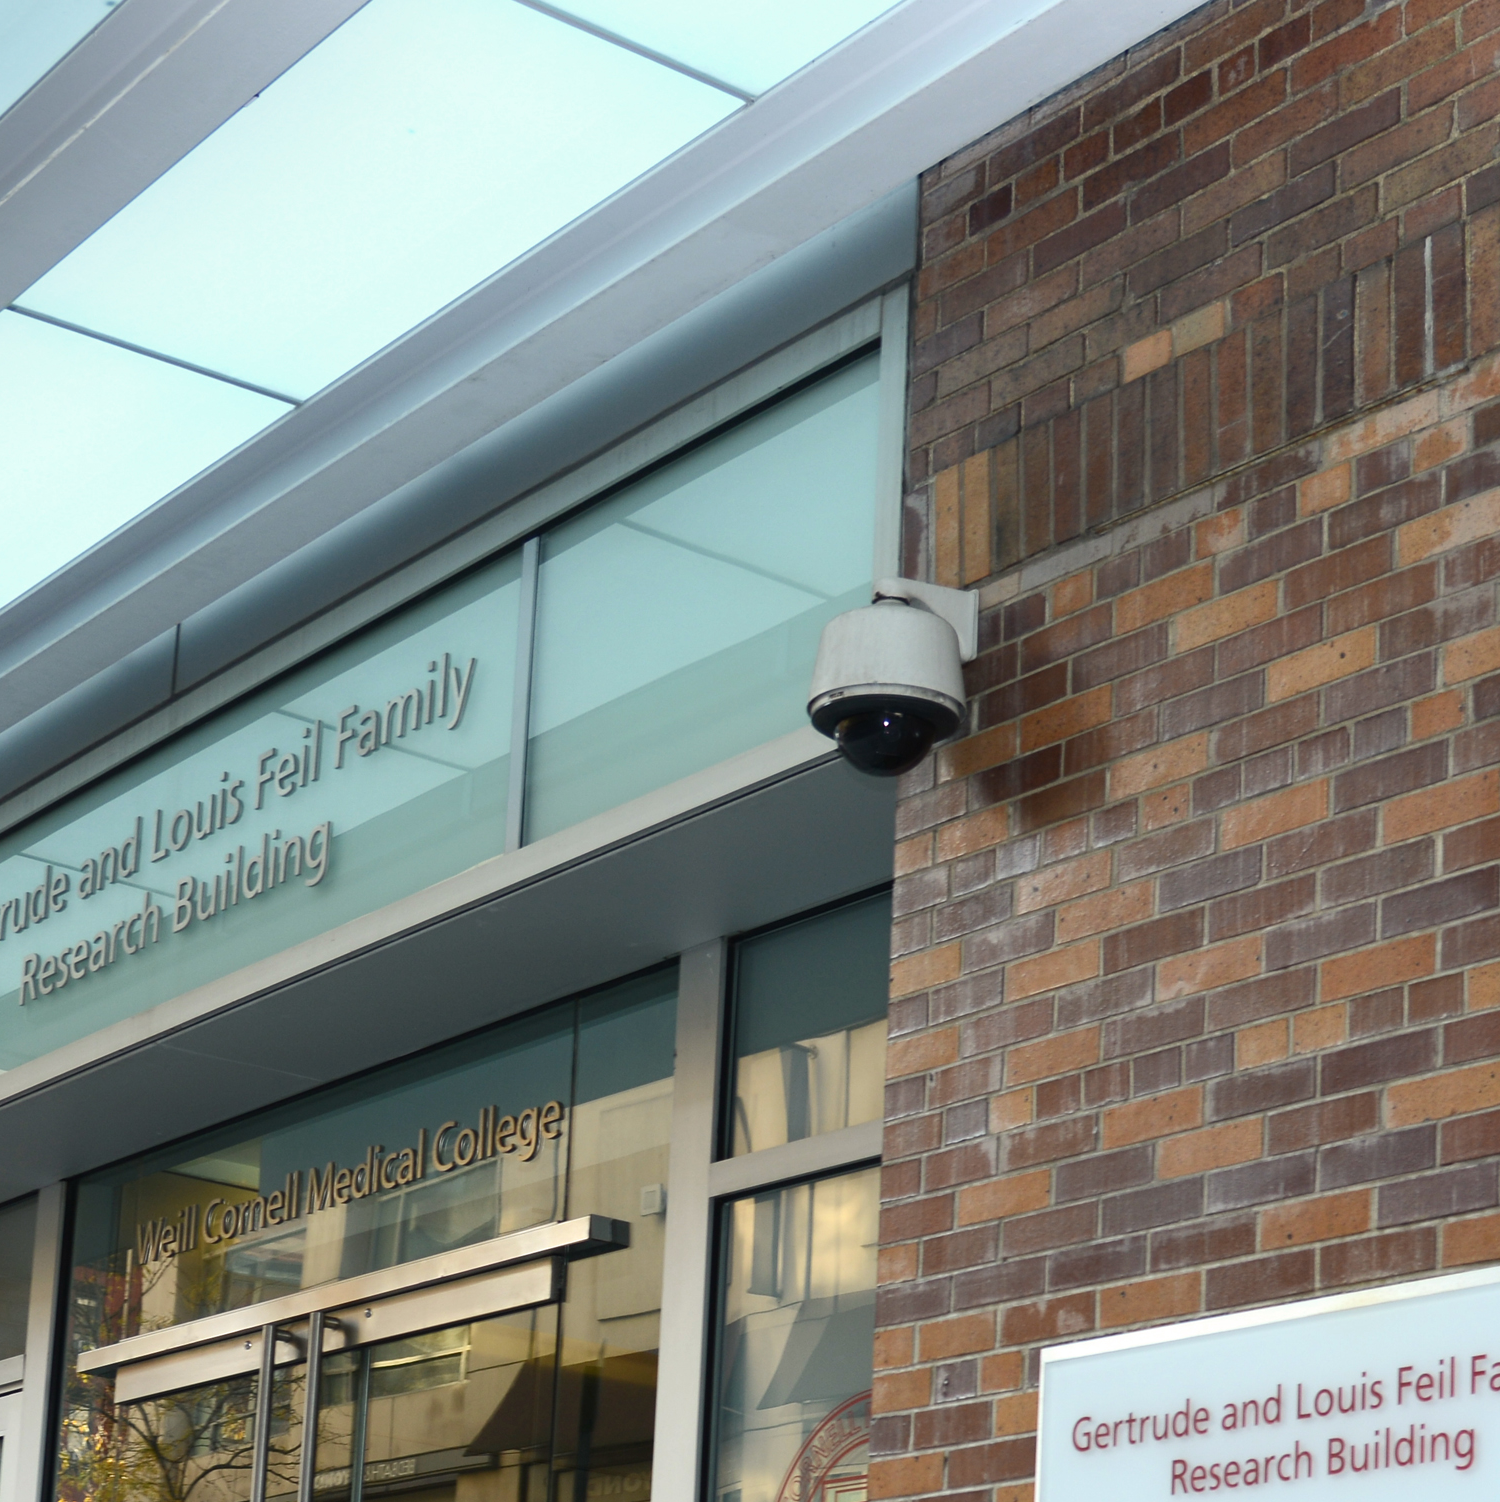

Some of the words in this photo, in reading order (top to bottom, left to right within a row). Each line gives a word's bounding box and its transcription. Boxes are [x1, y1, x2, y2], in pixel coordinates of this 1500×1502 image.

[77, 815, 143, 900] and
[151, 771, 246, 863] Louis
[254, 719, 323, 810] Feil
[334, 652, 479, 769] Family
[18, 891, 162, 1006] Research
[172, 820, 334, 934] Building
[137, 1204, 199, 1265] Weill
[202, 1169, 302, 1245] Cornell
[306, 1128, 427, 1215] Medical
[432, 1100, 564, 1172] College
[1071, 1398, 1211, 1453] Gertrude
[1221, 1384, 1284, 1432] and
[1295, 1372, 1383, 1420] Louis
[1397, 1356, 1457, 1405] Feil
[1170, 1440, 1314, 1496] Research
[1327, 1423, 1477, 1477] Building
